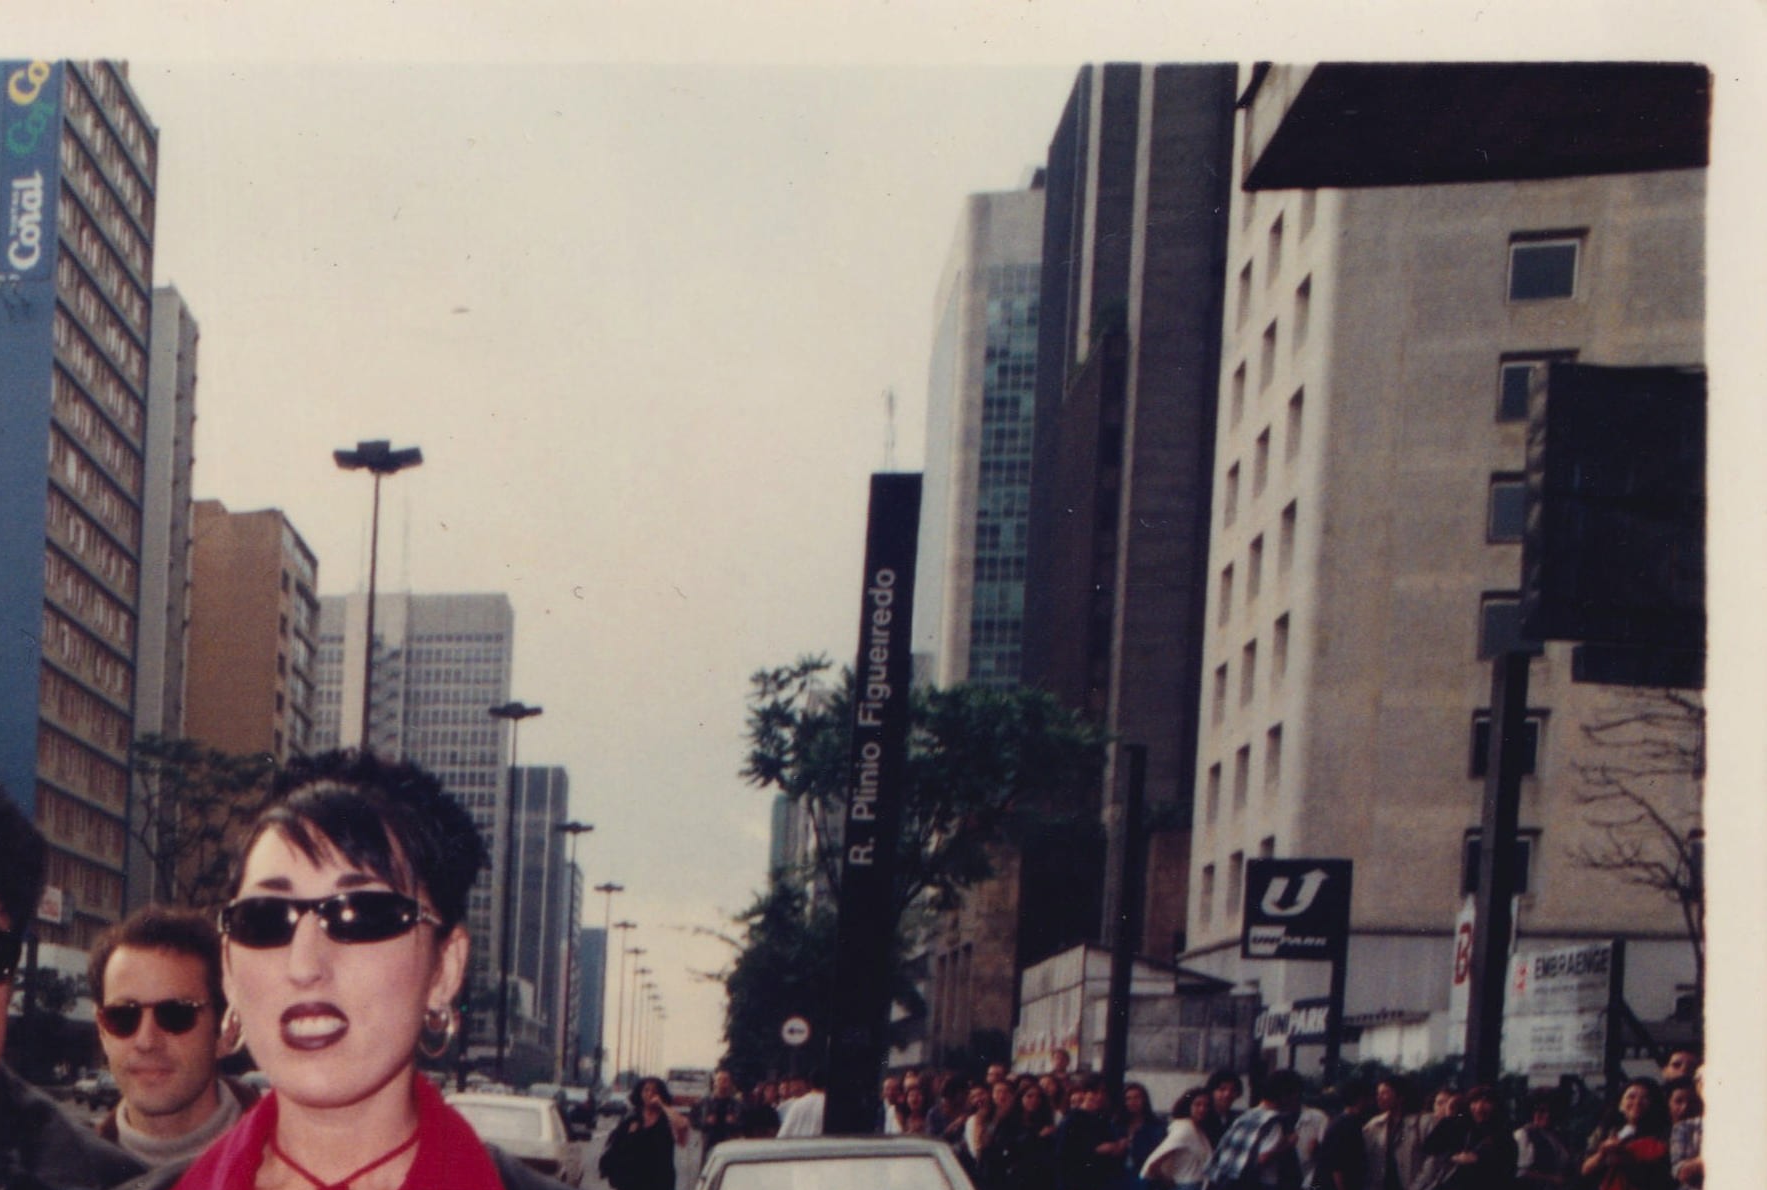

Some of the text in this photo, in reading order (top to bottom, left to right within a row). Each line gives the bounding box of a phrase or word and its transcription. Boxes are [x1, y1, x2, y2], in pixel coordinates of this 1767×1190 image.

[7, 170, 44, 271] Coral
[857, 567, 896, 728] Figueiredo
[849, 837, 875, 866] R.
